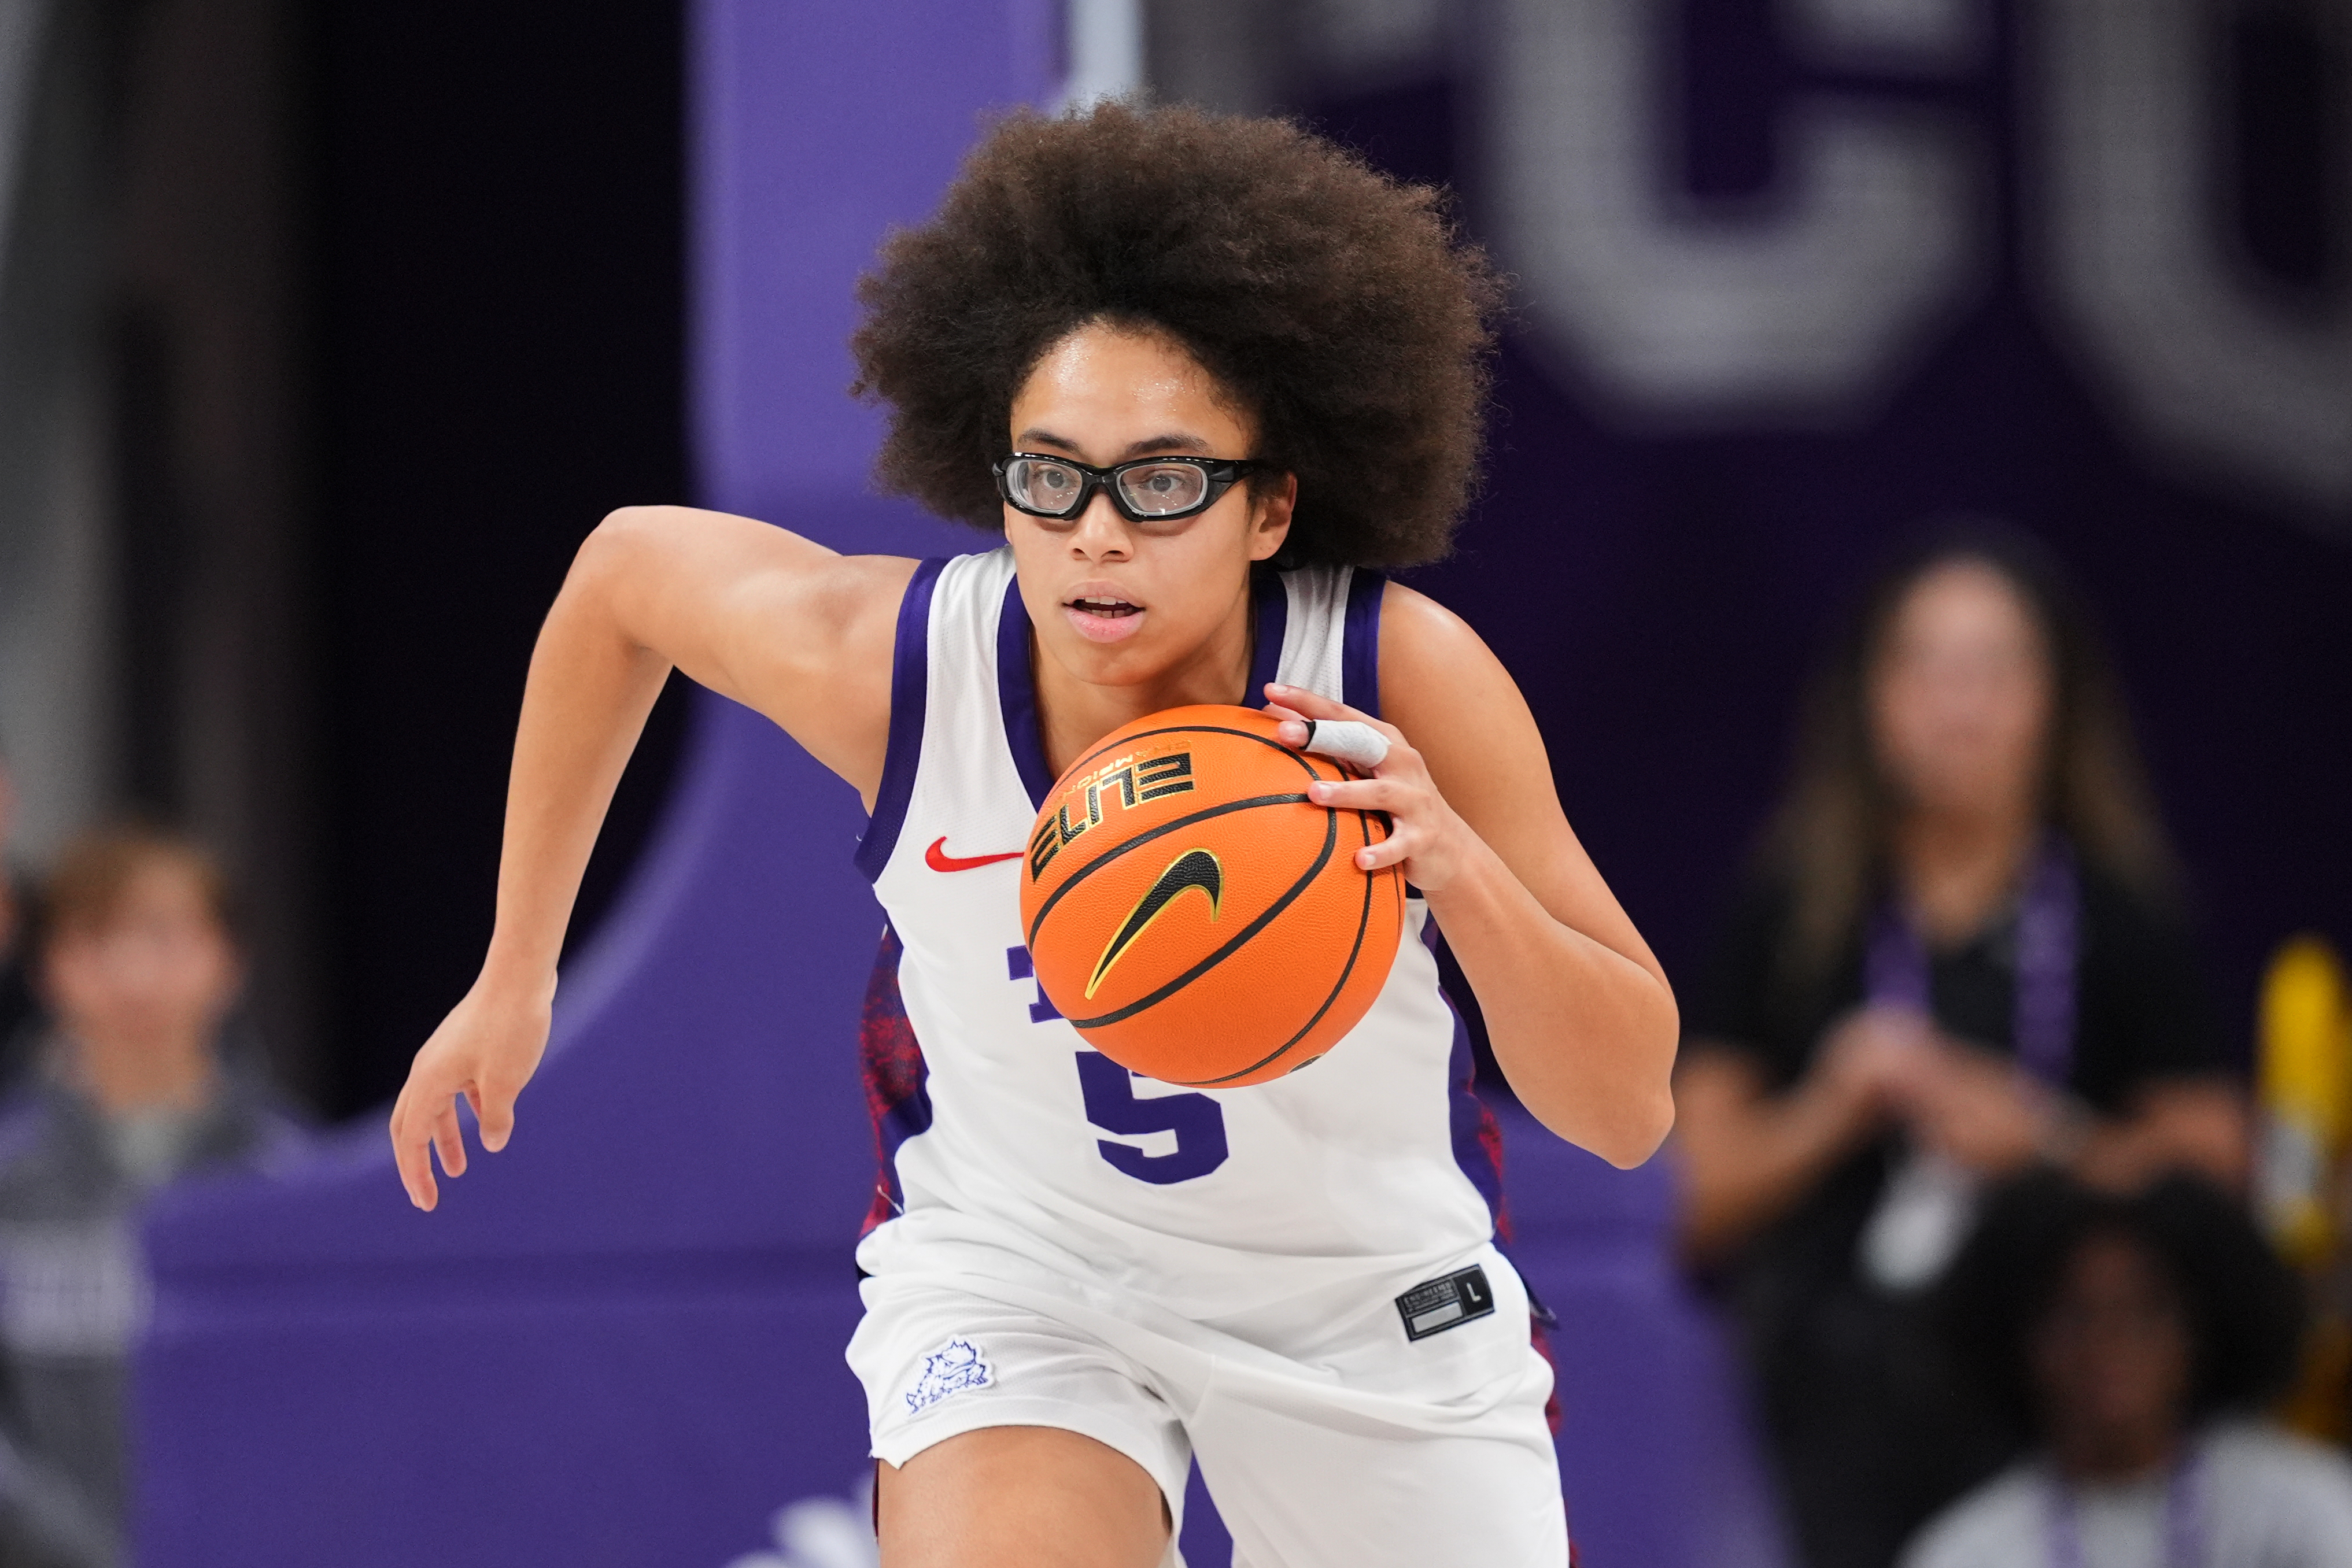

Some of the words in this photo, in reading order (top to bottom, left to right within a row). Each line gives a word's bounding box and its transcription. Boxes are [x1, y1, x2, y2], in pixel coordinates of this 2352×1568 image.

[1030, 752, 1195, 886] ELITE
[1076, 1051, 1229, 1185] 5
[1466, 1282, 1482, 1303] L
